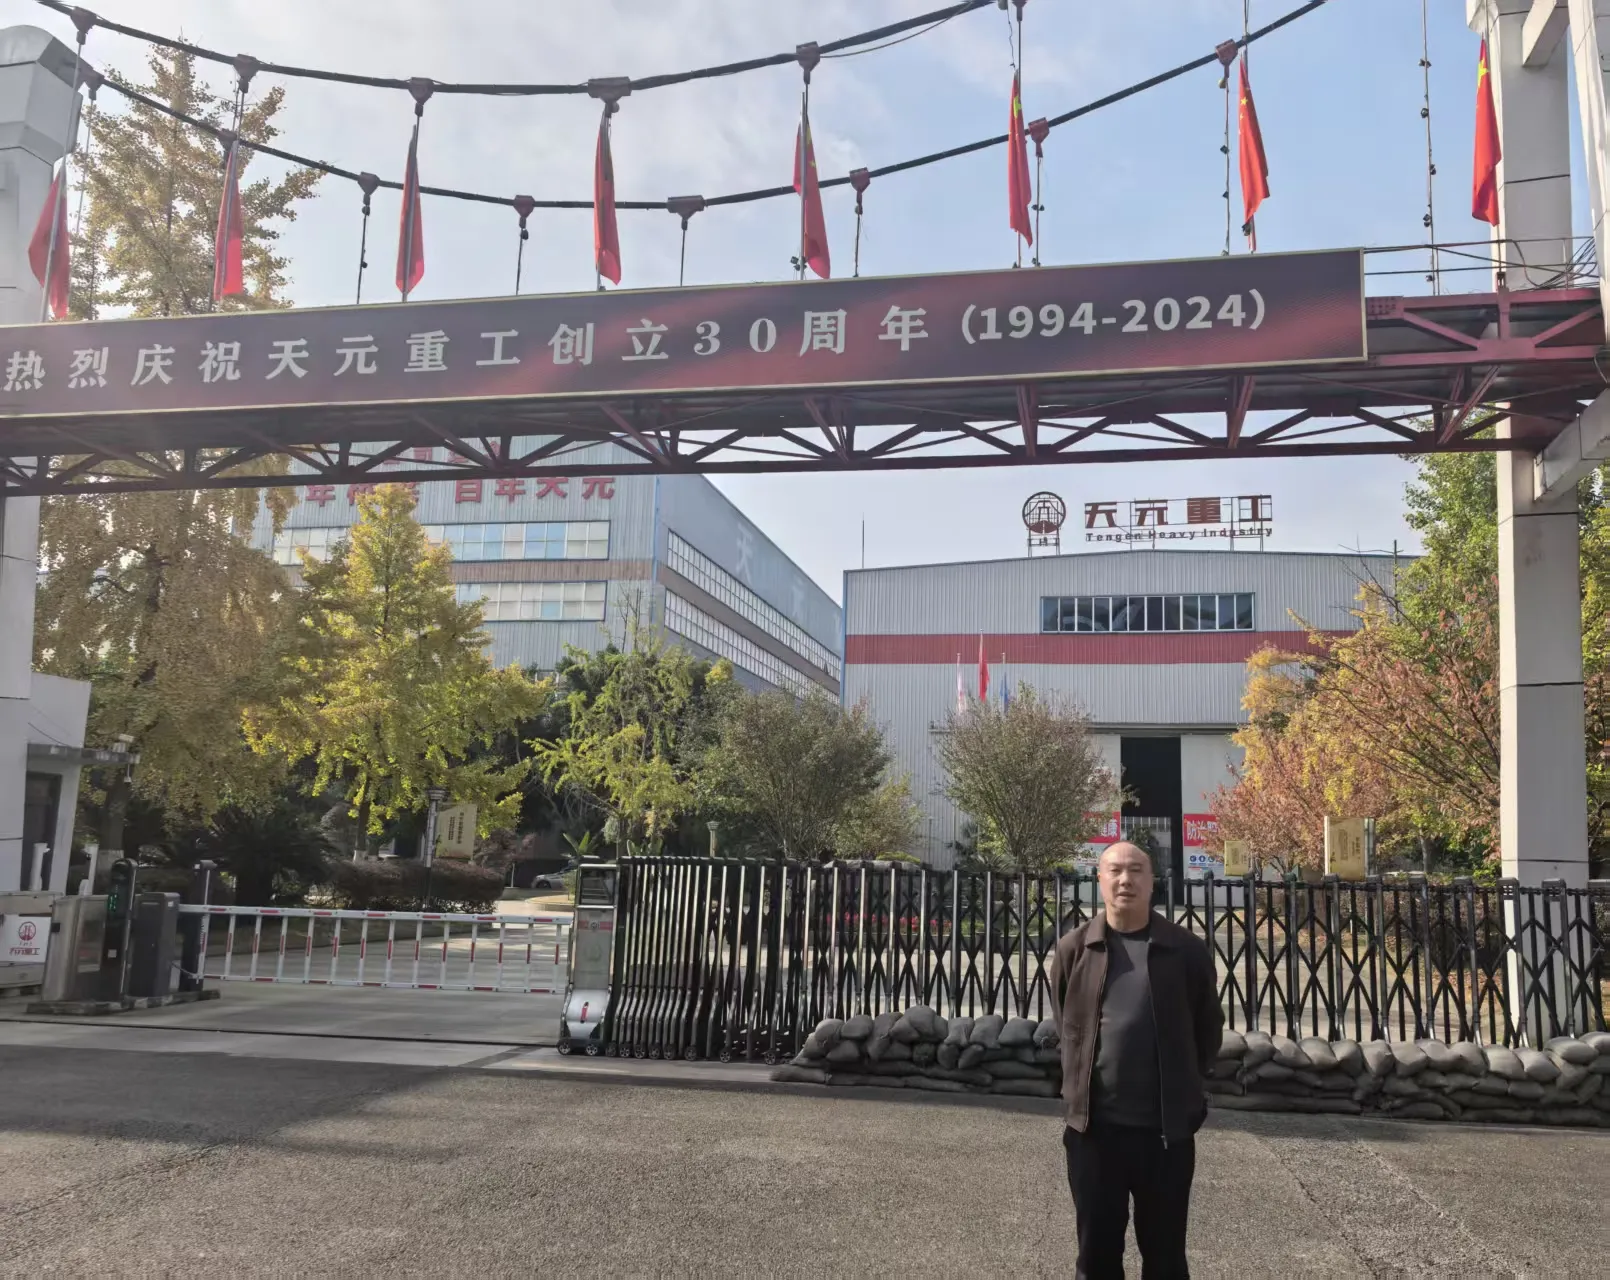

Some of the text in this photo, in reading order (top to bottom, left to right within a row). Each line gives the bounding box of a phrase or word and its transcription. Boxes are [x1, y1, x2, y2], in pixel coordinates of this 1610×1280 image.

[4, 288, 1266, 392] 热烈庆祝天元重工创立30周年 (1994-2024)
[1084, 494, 1273, 528] 天元重工
[1149, 529, 1196, 541] Heavy
[1203, 527, 1273, 538] Industry
